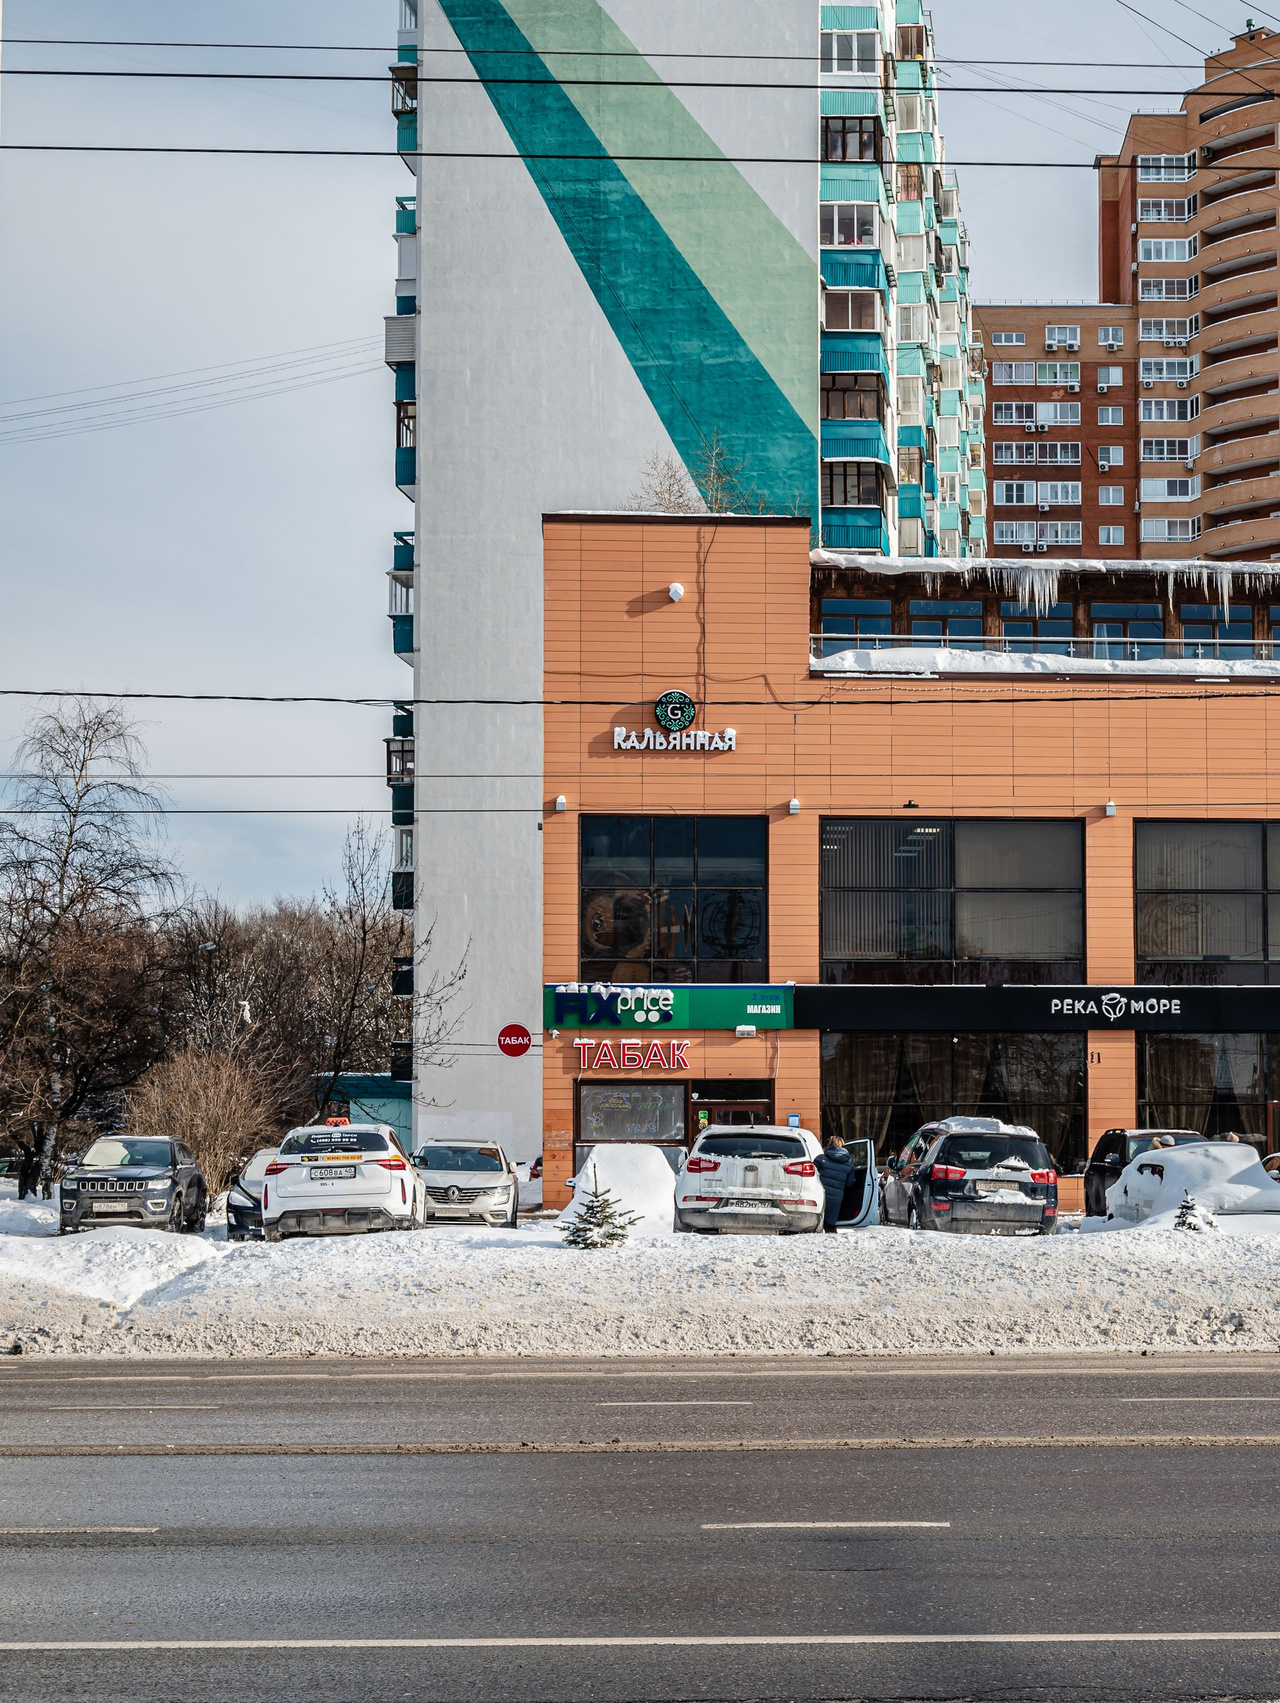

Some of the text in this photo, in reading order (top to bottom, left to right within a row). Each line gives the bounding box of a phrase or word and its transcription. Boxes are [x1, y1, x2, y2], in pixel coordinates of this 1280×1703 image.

[667, 704, 682, 719] G
[747, 1005, 781, 1014] МАГАЗИН
[1051, 999, 1181, 1014] РЕКА МОРЕ
[498, 1036, 530, 1045] ТАБАК
[574, 1040, 691, 1069] ТАБАК
